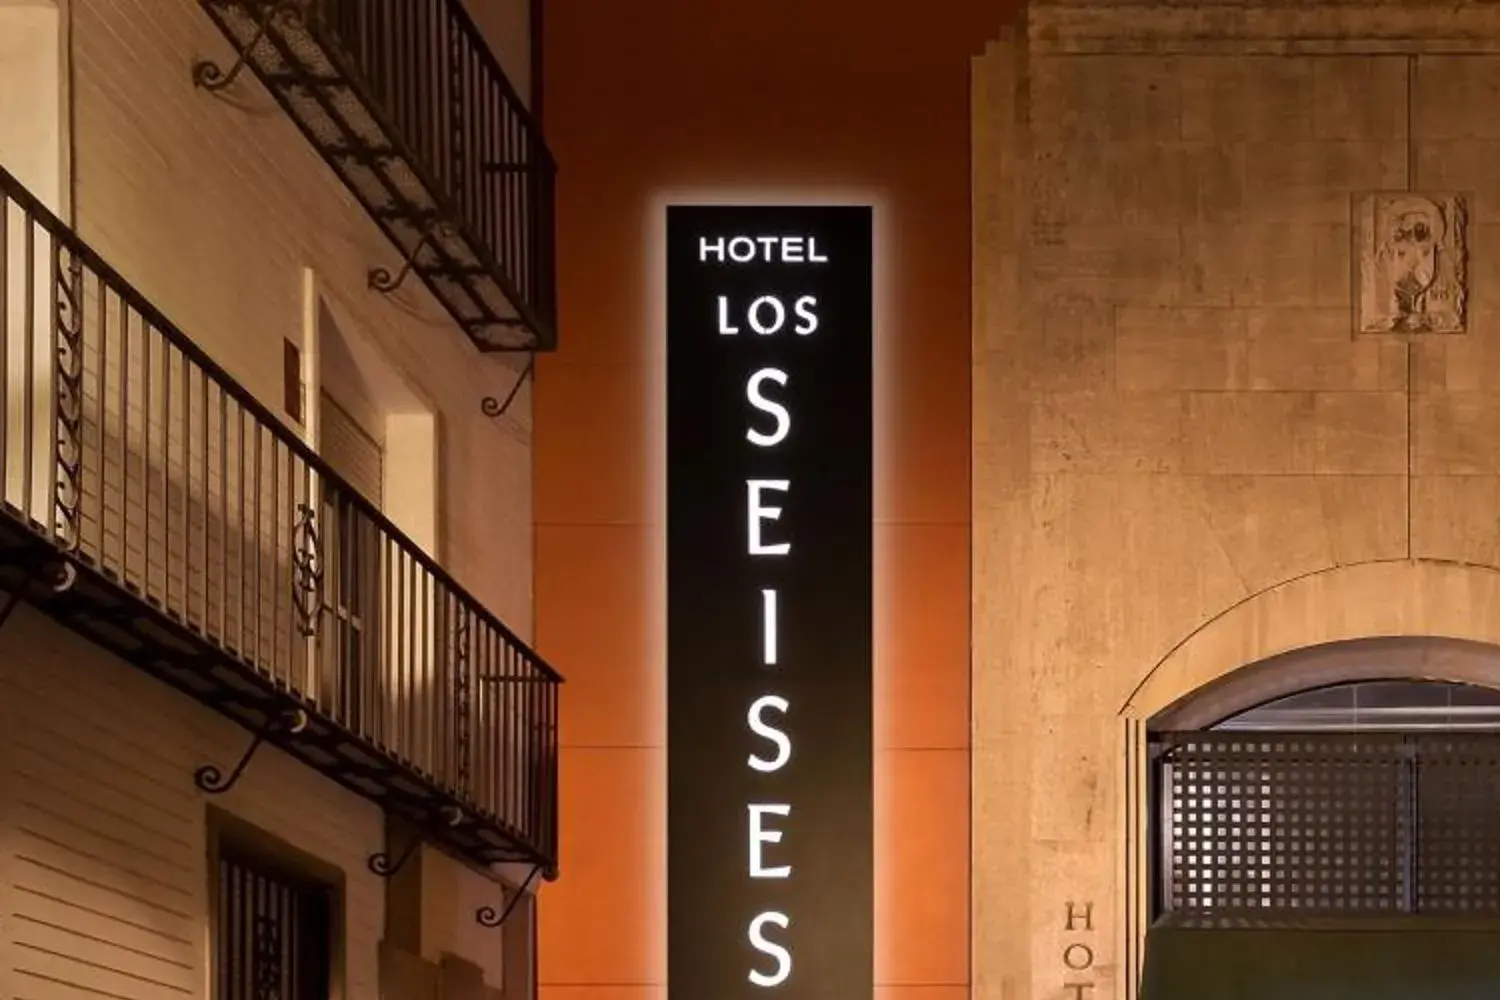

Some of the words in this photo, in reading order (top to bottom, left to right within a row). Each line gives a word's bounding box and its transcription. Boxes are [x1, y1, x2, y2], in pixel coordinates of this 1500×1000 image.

[699, 236, 828, 262] HOTEL
[718, 295, 818, 336] LOS
[746, 367, 793, 988] SEISES
